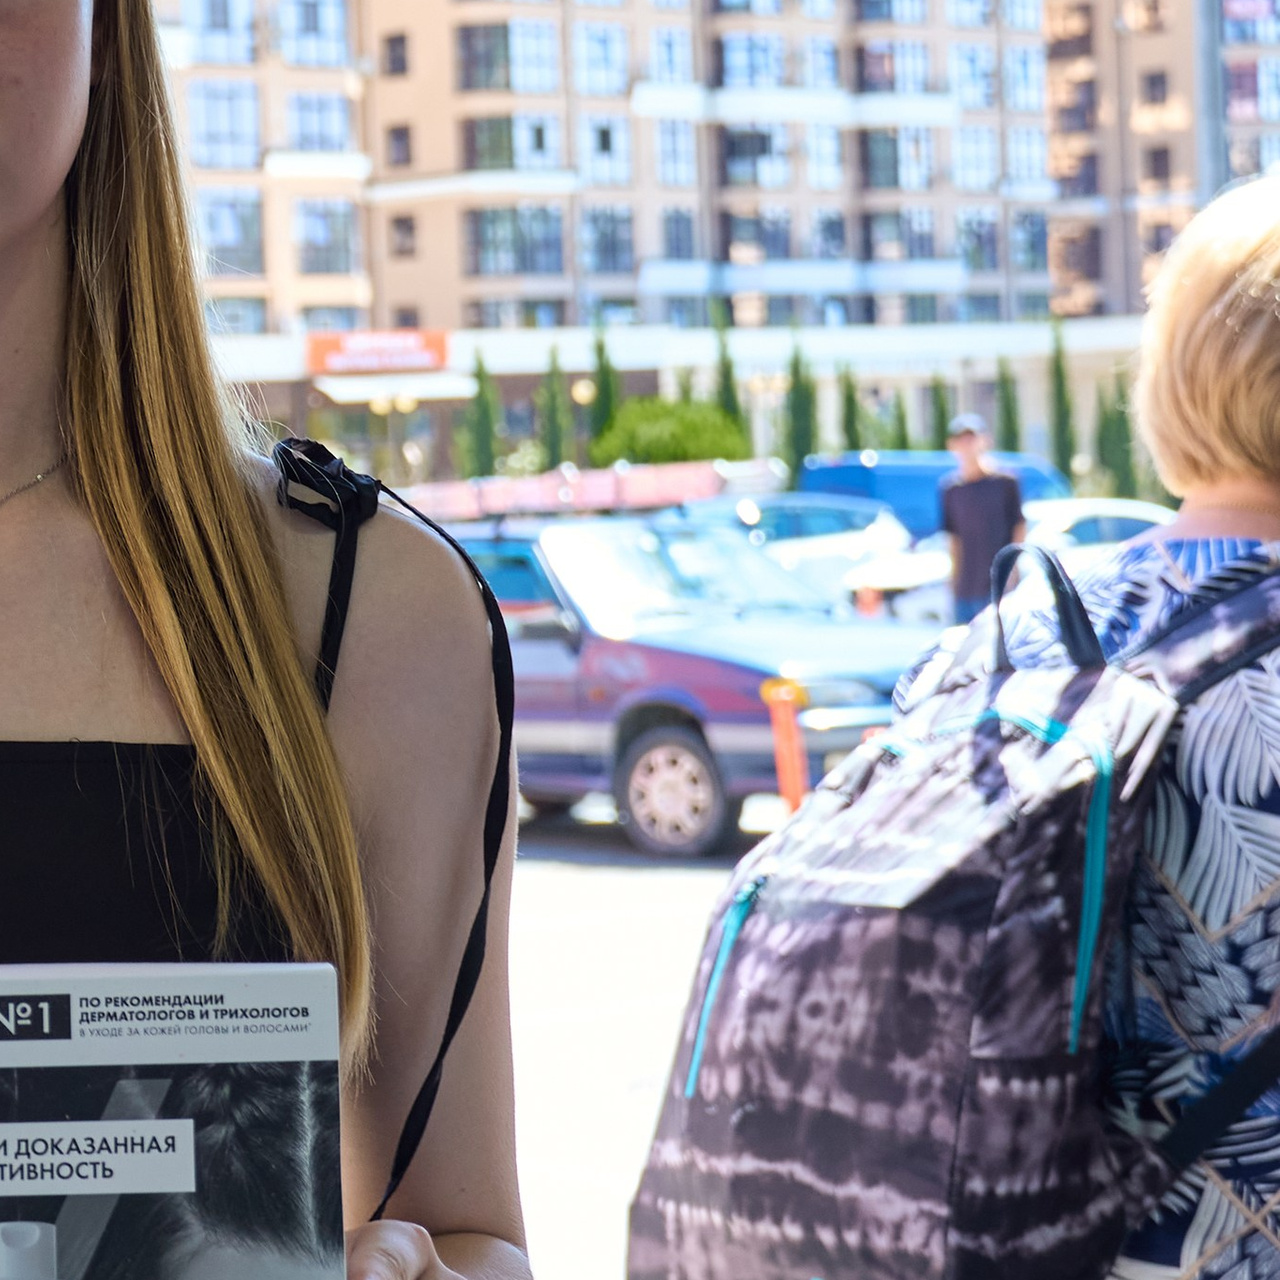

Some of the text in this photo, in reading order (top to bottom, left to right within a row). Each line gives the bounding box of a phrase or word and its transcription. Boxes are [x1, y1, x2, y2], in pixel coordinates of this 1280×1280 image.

[79, 994, 225, 1008] ПО РЕКОМЕНДАЦИИ
[79, 1006, 310, 1024] ДЕРМАТОЛОГОВ И ТРИХОЛОГОВ
[89, 1027, 123, 1038] УХОДЕ
[127, 1026, 141, 1037] ЗА
[143, 1024, 182, 1036] КОЖЕЙ
[184, 1024, 230, 1036] ГОЛОВЫ
[232, 1025, 240, 1034] И
[14, 1136, 176, 1159] ДОКАЗАННАЯ
